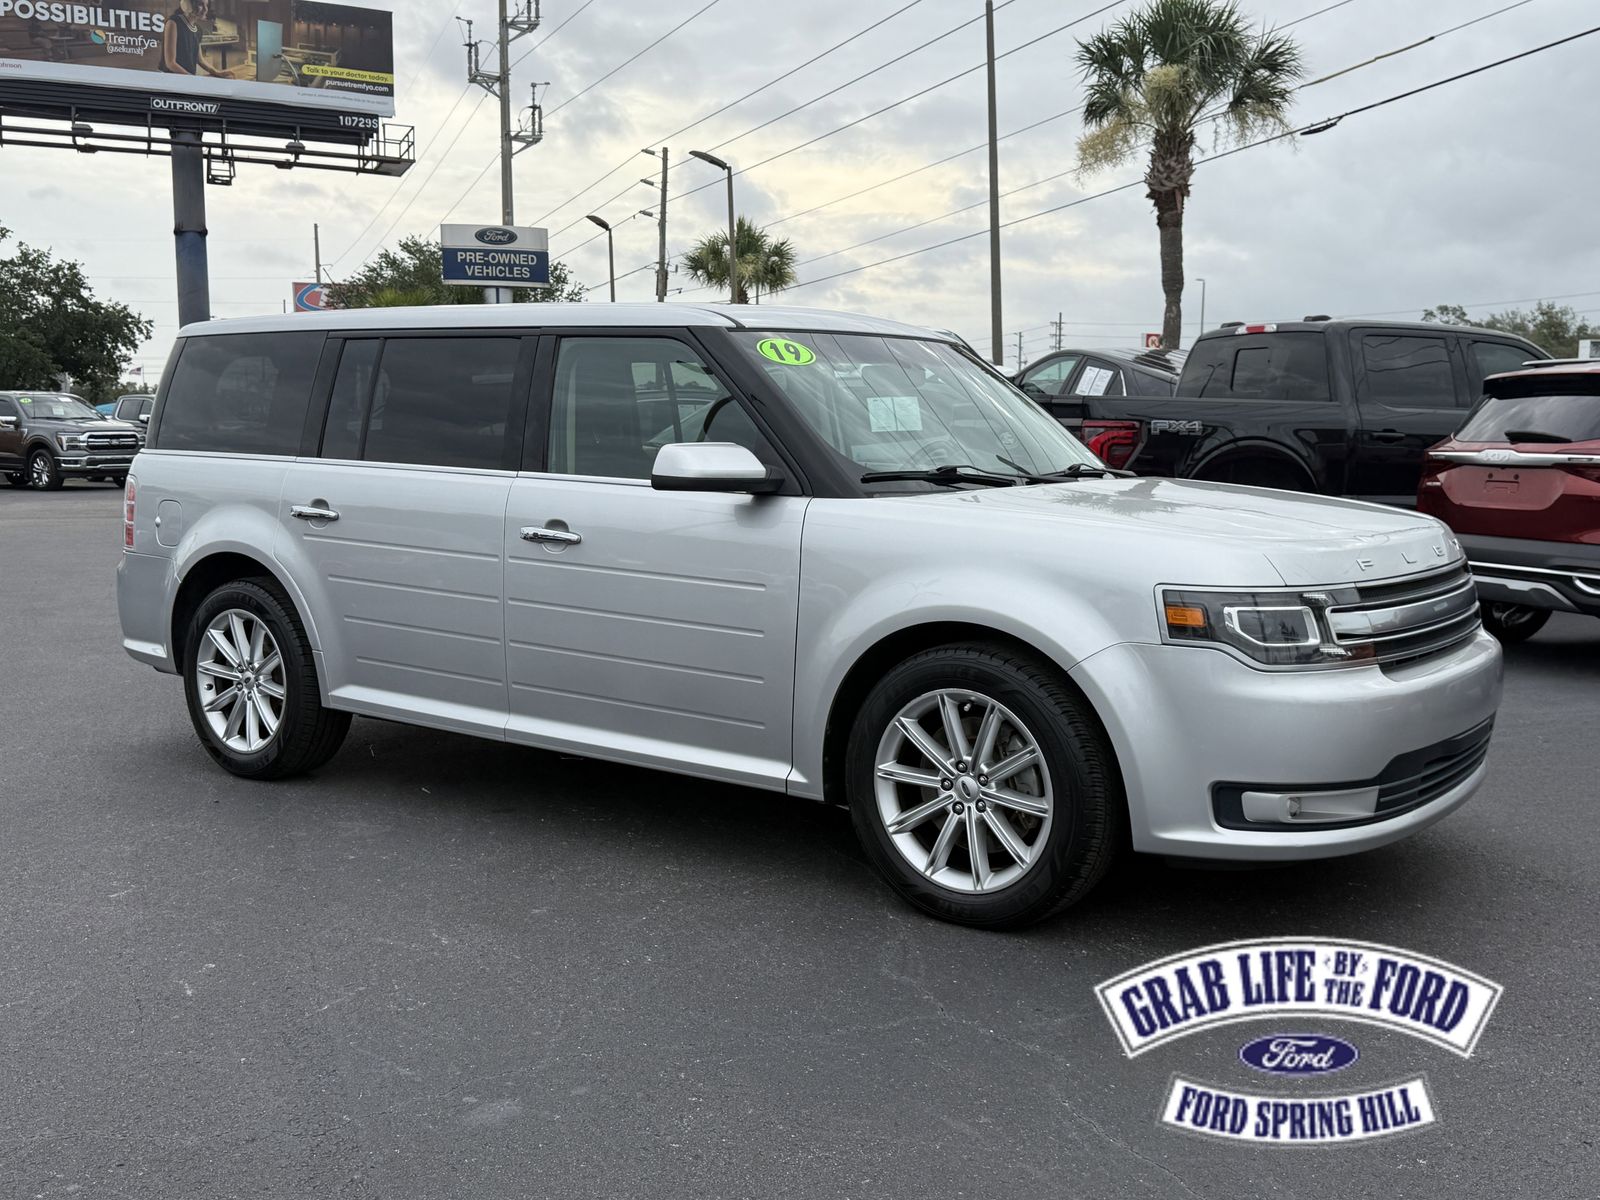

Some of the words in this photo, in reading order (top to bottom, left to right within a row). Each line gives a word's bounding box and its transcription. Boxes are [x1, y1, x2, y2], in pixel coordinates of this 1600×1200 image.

[0, 0, 165, 33] POSSIBILITIES
[105, 32, 158, 50] Tremfya
[306, 66, 319, 74] Talk
[346, 71, 367, 79] doctor
[325, 79, 389, 92] pursuetremfya.com
[483, 230, 510, 241] Ford
[457, 251, 537, 265] PRE-OWNED
[465, 264, 531, 278] VEHICLES
[769, 341, 801, 362] 19
[1150, 419, 1202, 436] FX4
